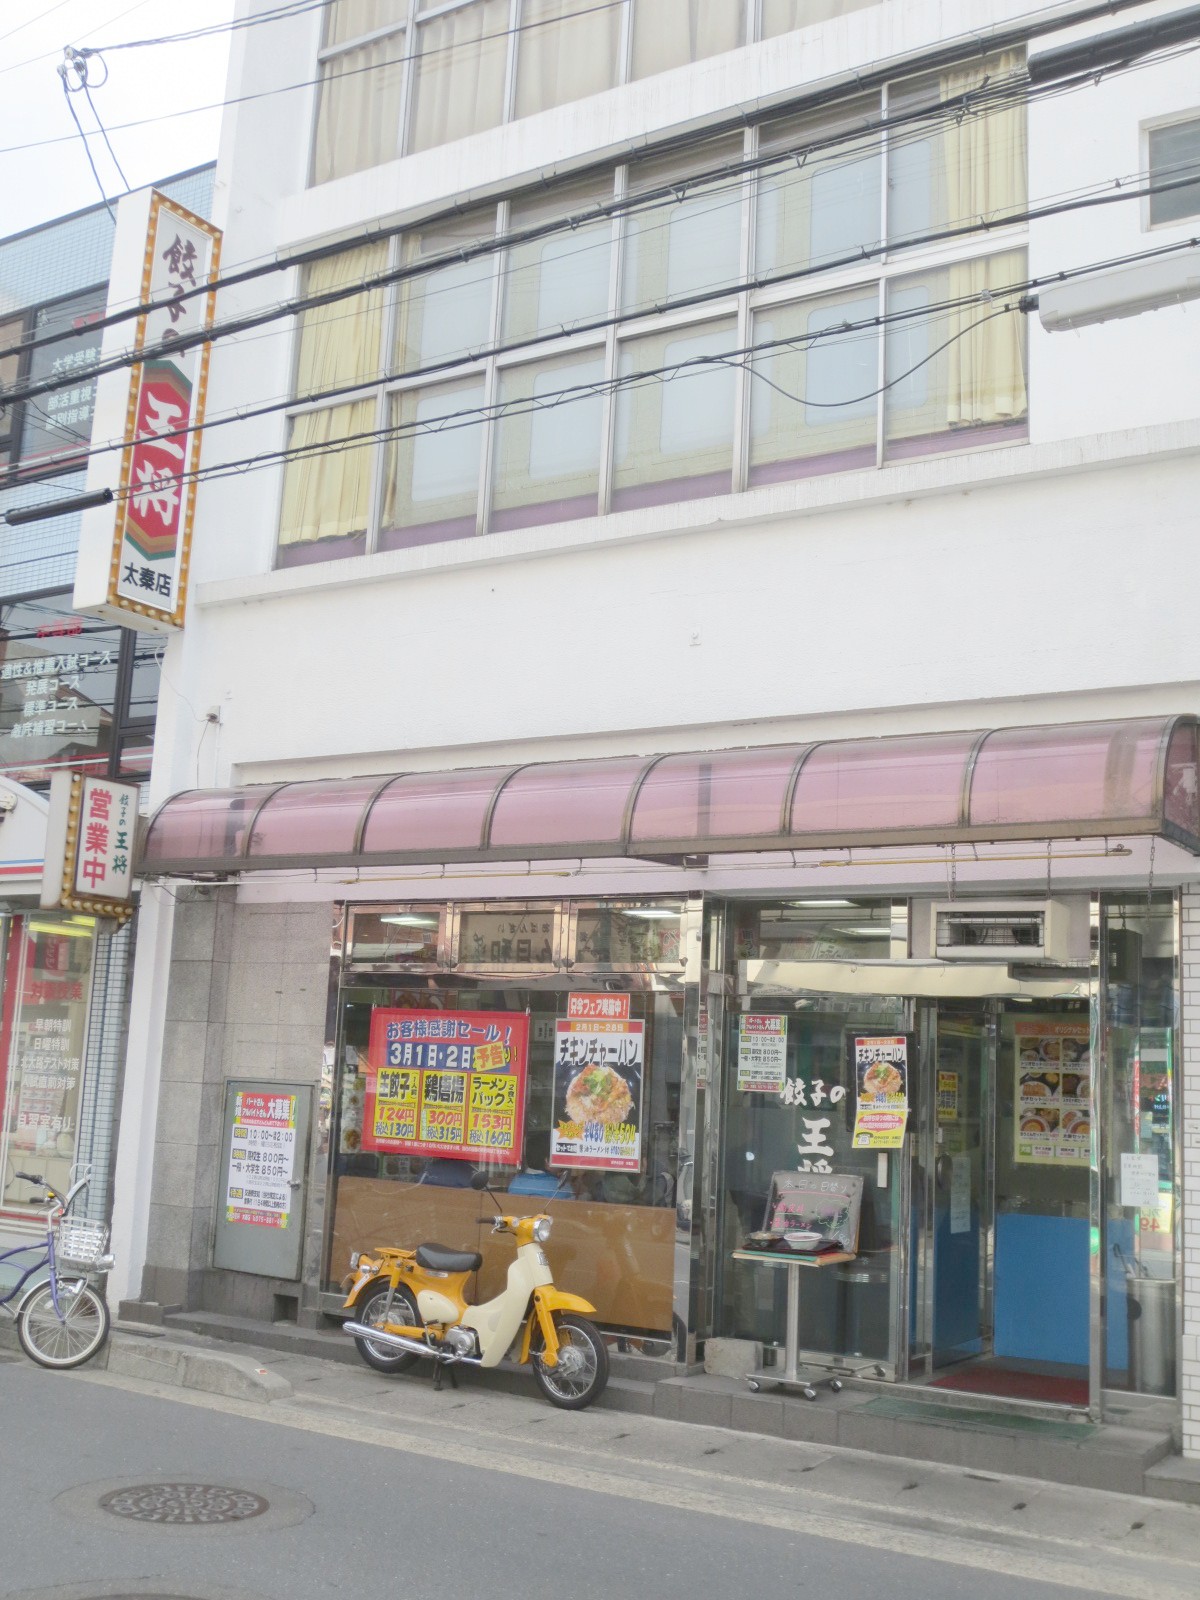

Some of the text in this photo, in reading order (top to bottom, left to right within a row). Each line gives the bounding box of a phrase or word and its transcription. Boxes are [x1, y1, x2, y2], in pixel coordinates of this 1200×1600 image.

[47, 385, 97, 411] 部活重視
[122, 562, 171, 597] 太秦店
[25, 675, 80, 697] 発展コース
[83, 787, 112, 889] 営業中
[387, 1019, 512, 1045] お客様感謝セール!
[476, 1044, 503, 1069] 予告
[560, 1036, 638, 1066] チキンチャーハン
[473, 1076, 507, 1091] ラーメン
[779, 1077, 846, 1107] 餃子の
[472, 1092, 506, 1107] パック
[379, 1106, 415, 1123] 124円
[429, 1110, 463, 1127] 300円
[473, 1113, 512, 1131] 153円
